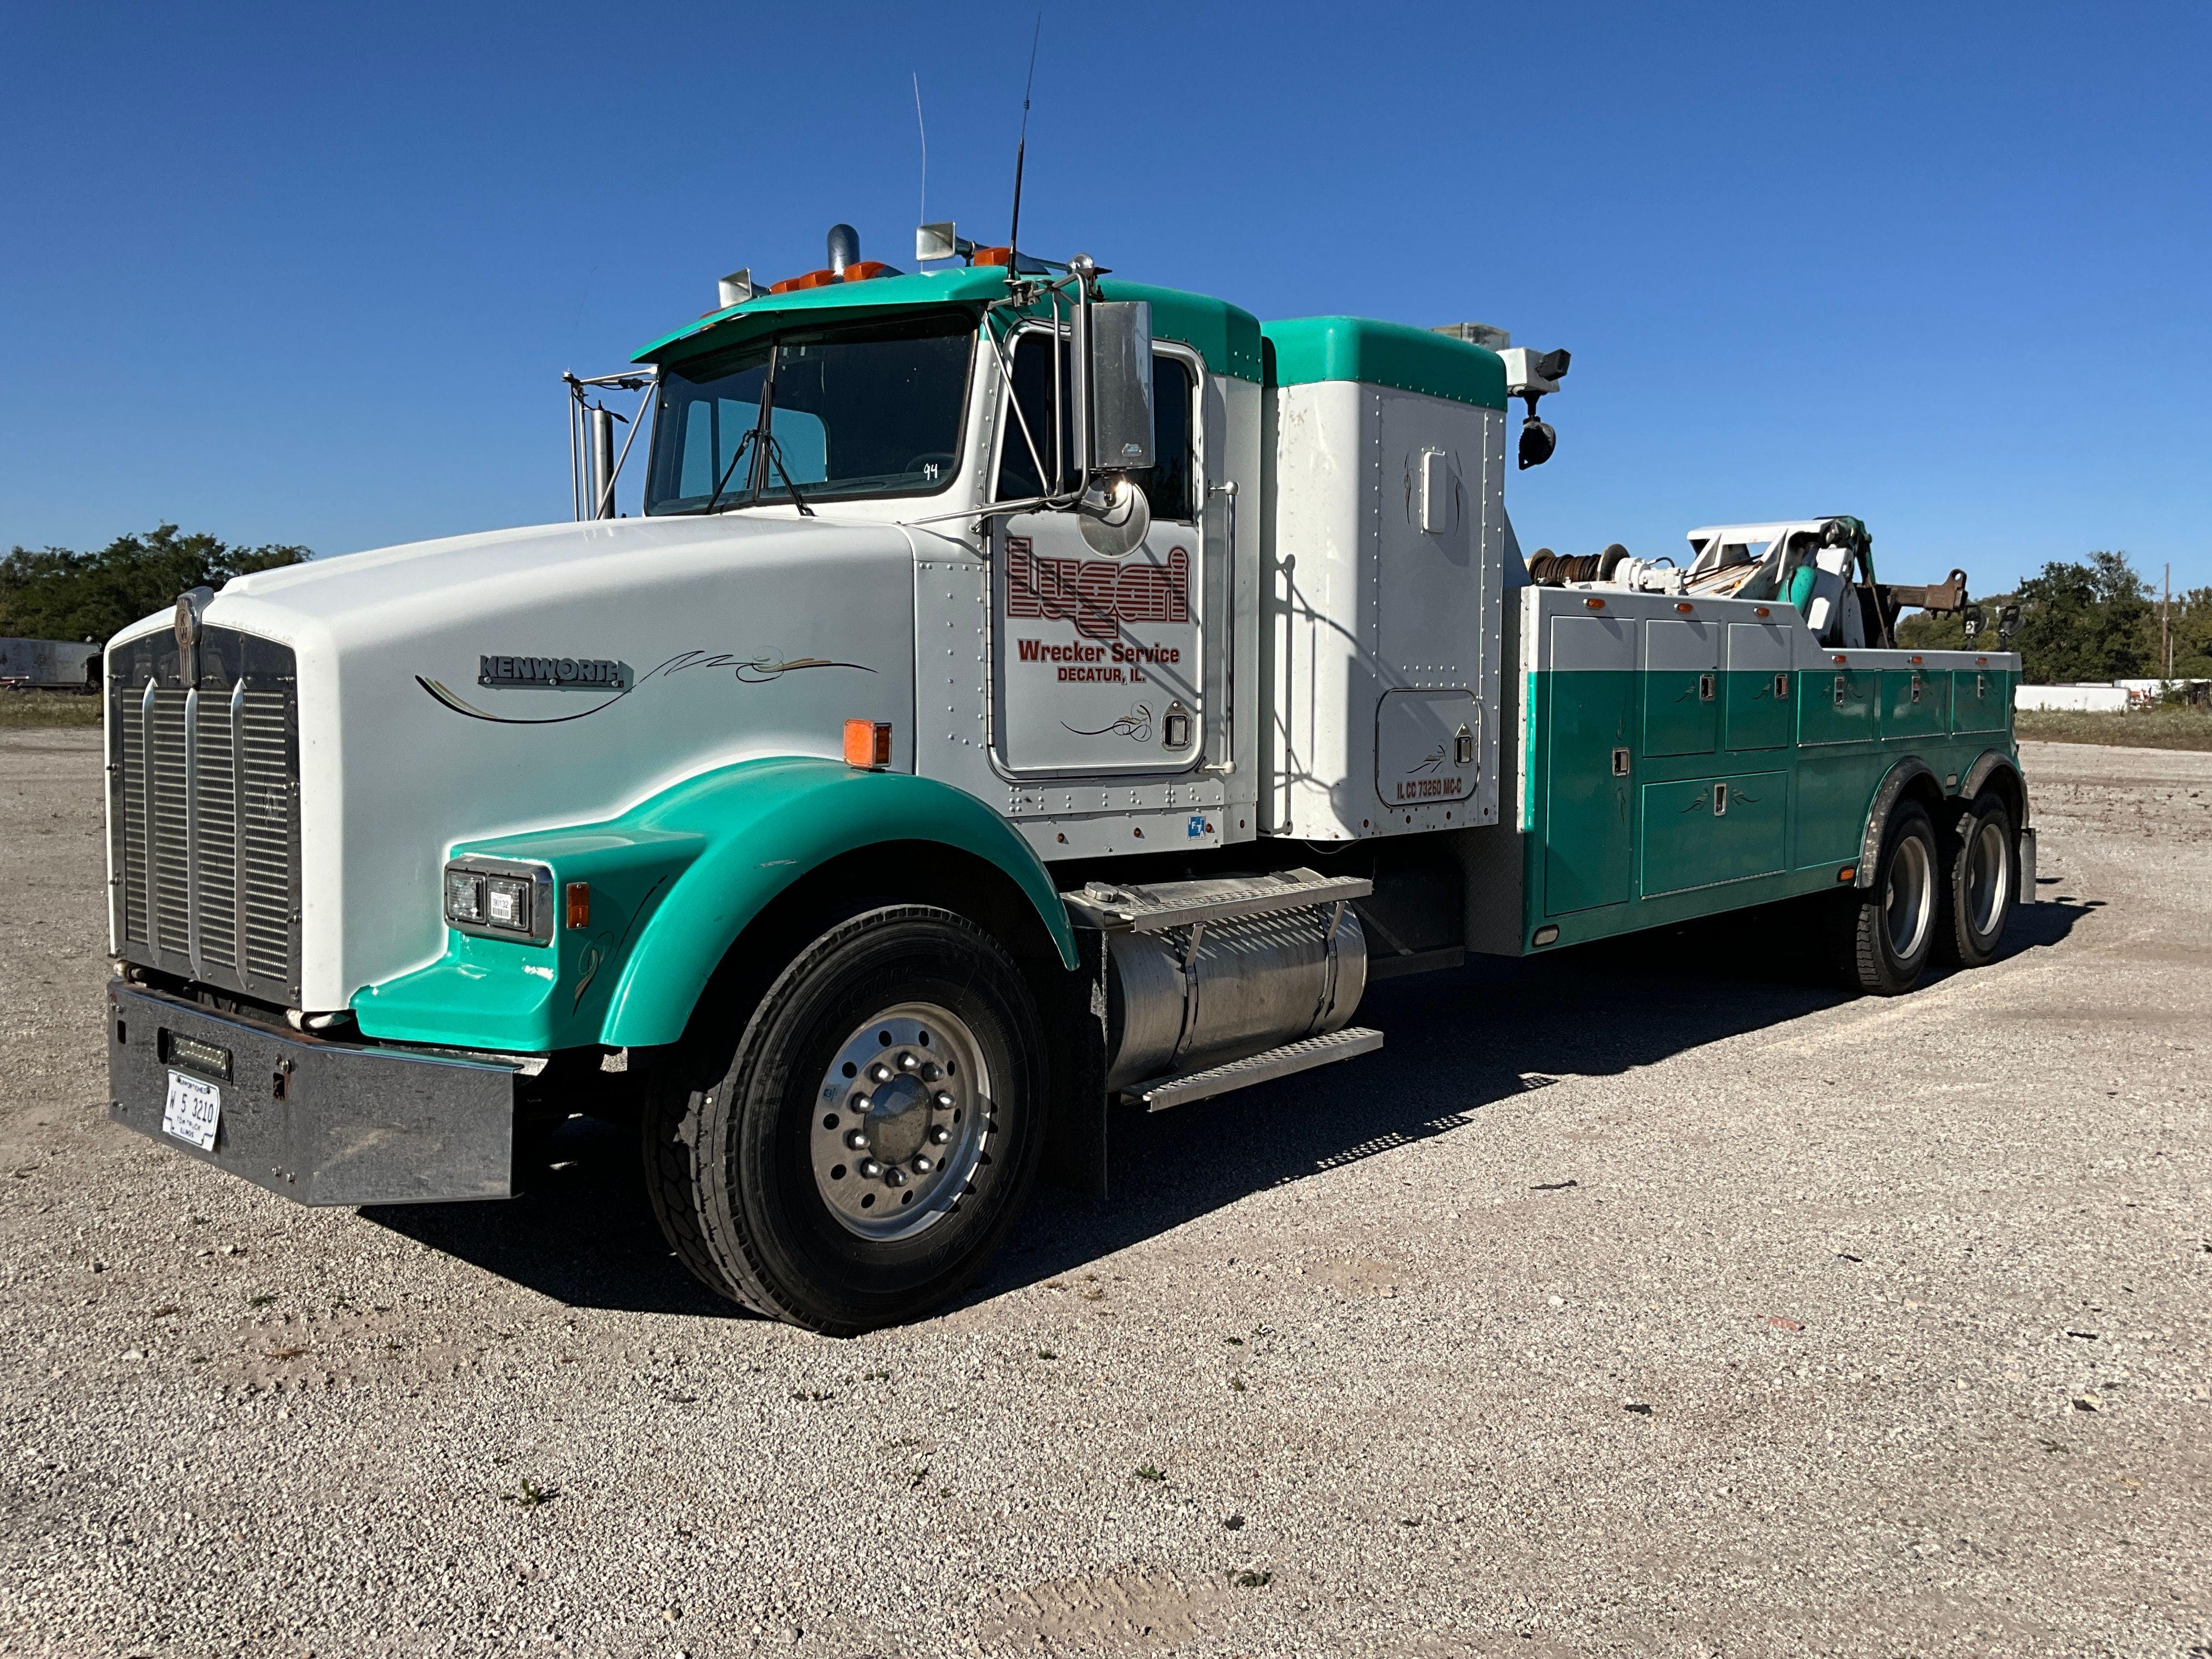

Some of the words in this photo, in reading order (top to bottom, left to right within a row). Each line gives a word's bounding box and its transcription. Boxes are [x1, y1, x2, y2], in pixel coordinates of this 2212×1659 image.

[924, 463, 938, 481] 94
[1018, 640, 1105, 662] Wrecker
[1111, 641, 1180, 663] Service
[479, 655, 624, 682] KENWORTH
[1058, 667, 1126, 684] DECATUR,
[1130, 667, 1146, 681] IL.
[1407, 782, 1416, 798] CC
[1418, 780, 1441, 797] 73260
[1443, 778, 1462, 794] MC-C
[181, 1093, 187, 1113] 5
[192, 1097, 213, 1124] 3210
